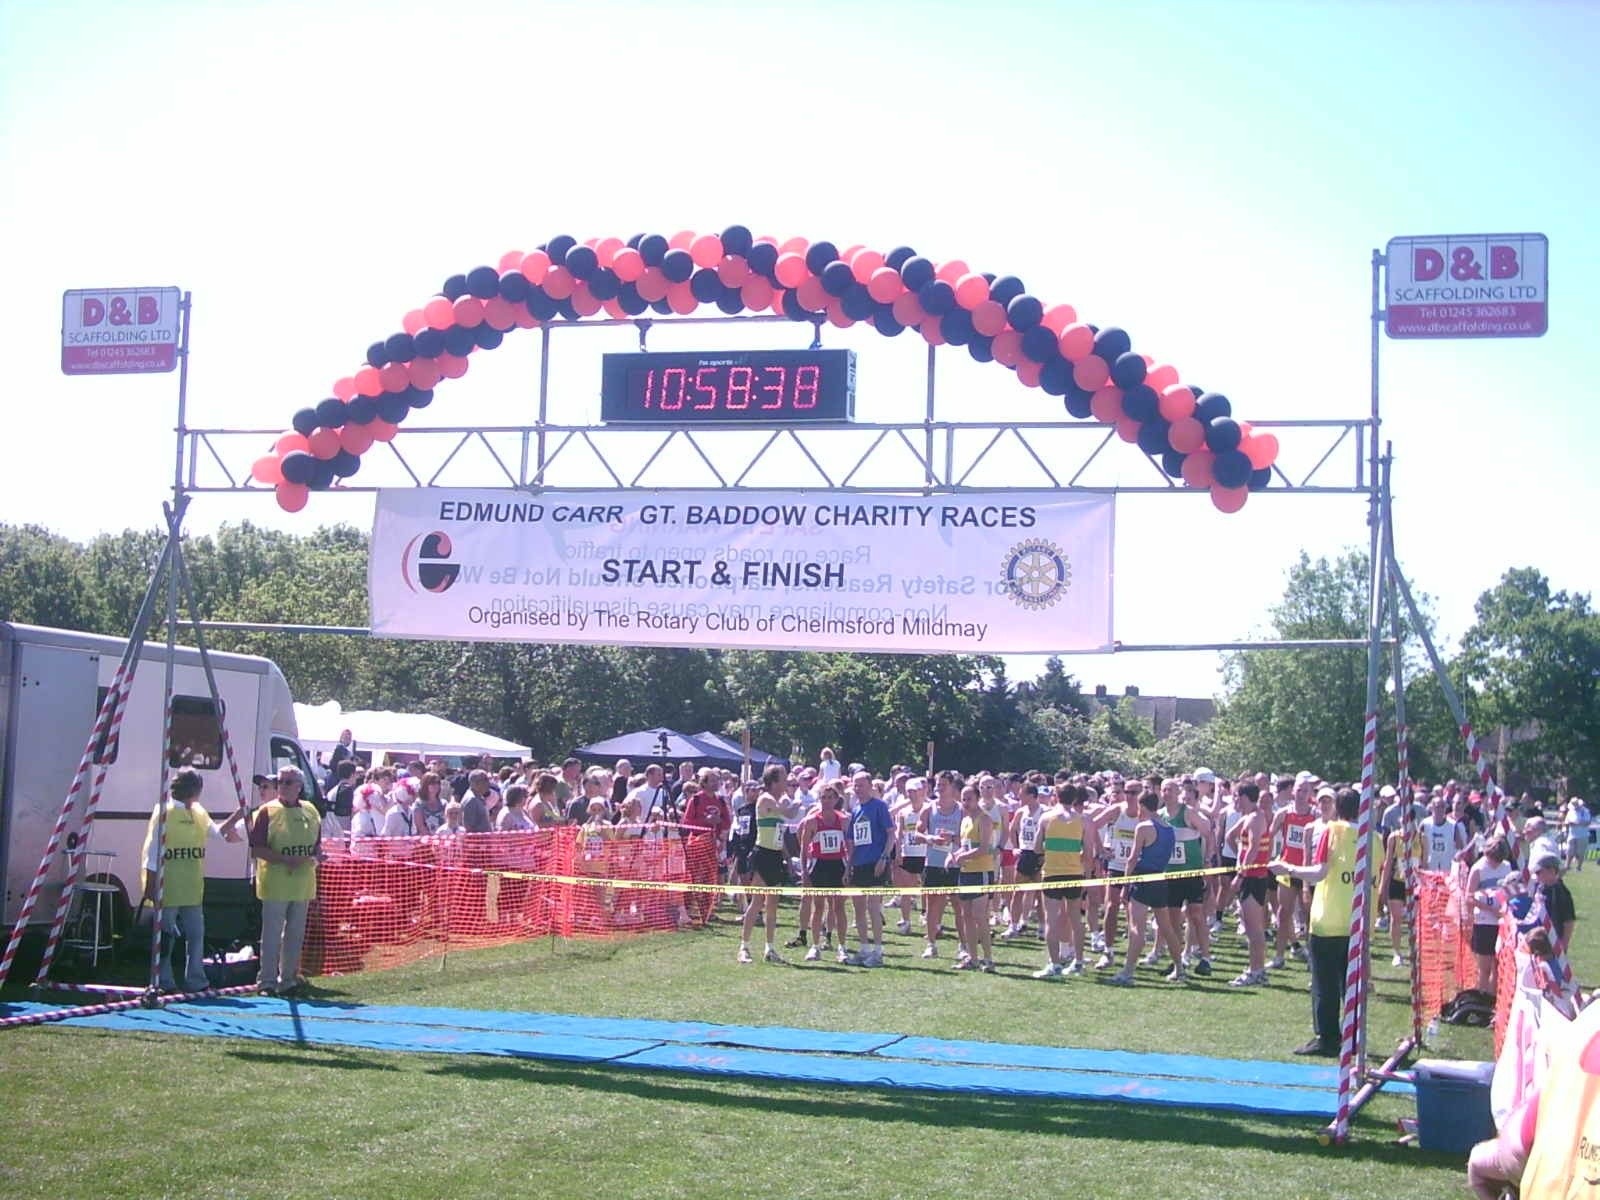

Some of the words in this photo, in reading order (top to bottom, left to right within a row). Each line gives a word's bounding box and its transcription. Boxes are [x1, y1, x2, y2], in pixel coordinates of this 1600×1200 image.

[1414, 245, 1520, 282] D&B
[1394, 286, 1504, 302] SCAFFOLDING
[1509, 285, 1537, 299] LTD
[83, 296, 160, 327] D&B
[69, 329, 148, 343] SCAFFOLDING
[151, 329, 172, 341] LTD
[643, 366, 820, 410] 10:58:38
[439, 501, 545, 523] EDMUND
[552, 505, 624, 524] CARR
[640, 505, 677, 524] GT.
[686, 505, 807, 526] BADDOW
[814, 505, 933, 527] CHARITY
[941, 506, 1036, 528] RACES
[601, 558, 702, 585] START
[710, 560, 731, 586] &
[742, 561, 845, 588] FINISH
[468, 606, 561, 628] Organised
[567, 609, 588, 631] by
[594, 609, 630, 628] The
[637, 611, 699, 633] Rotary
[705, 612, 750, 632] Club
[756, 614, 776, 632] of
[781, 614, 895, 636] Chelmsford
[902, 616, 988, 642] Mildmay
